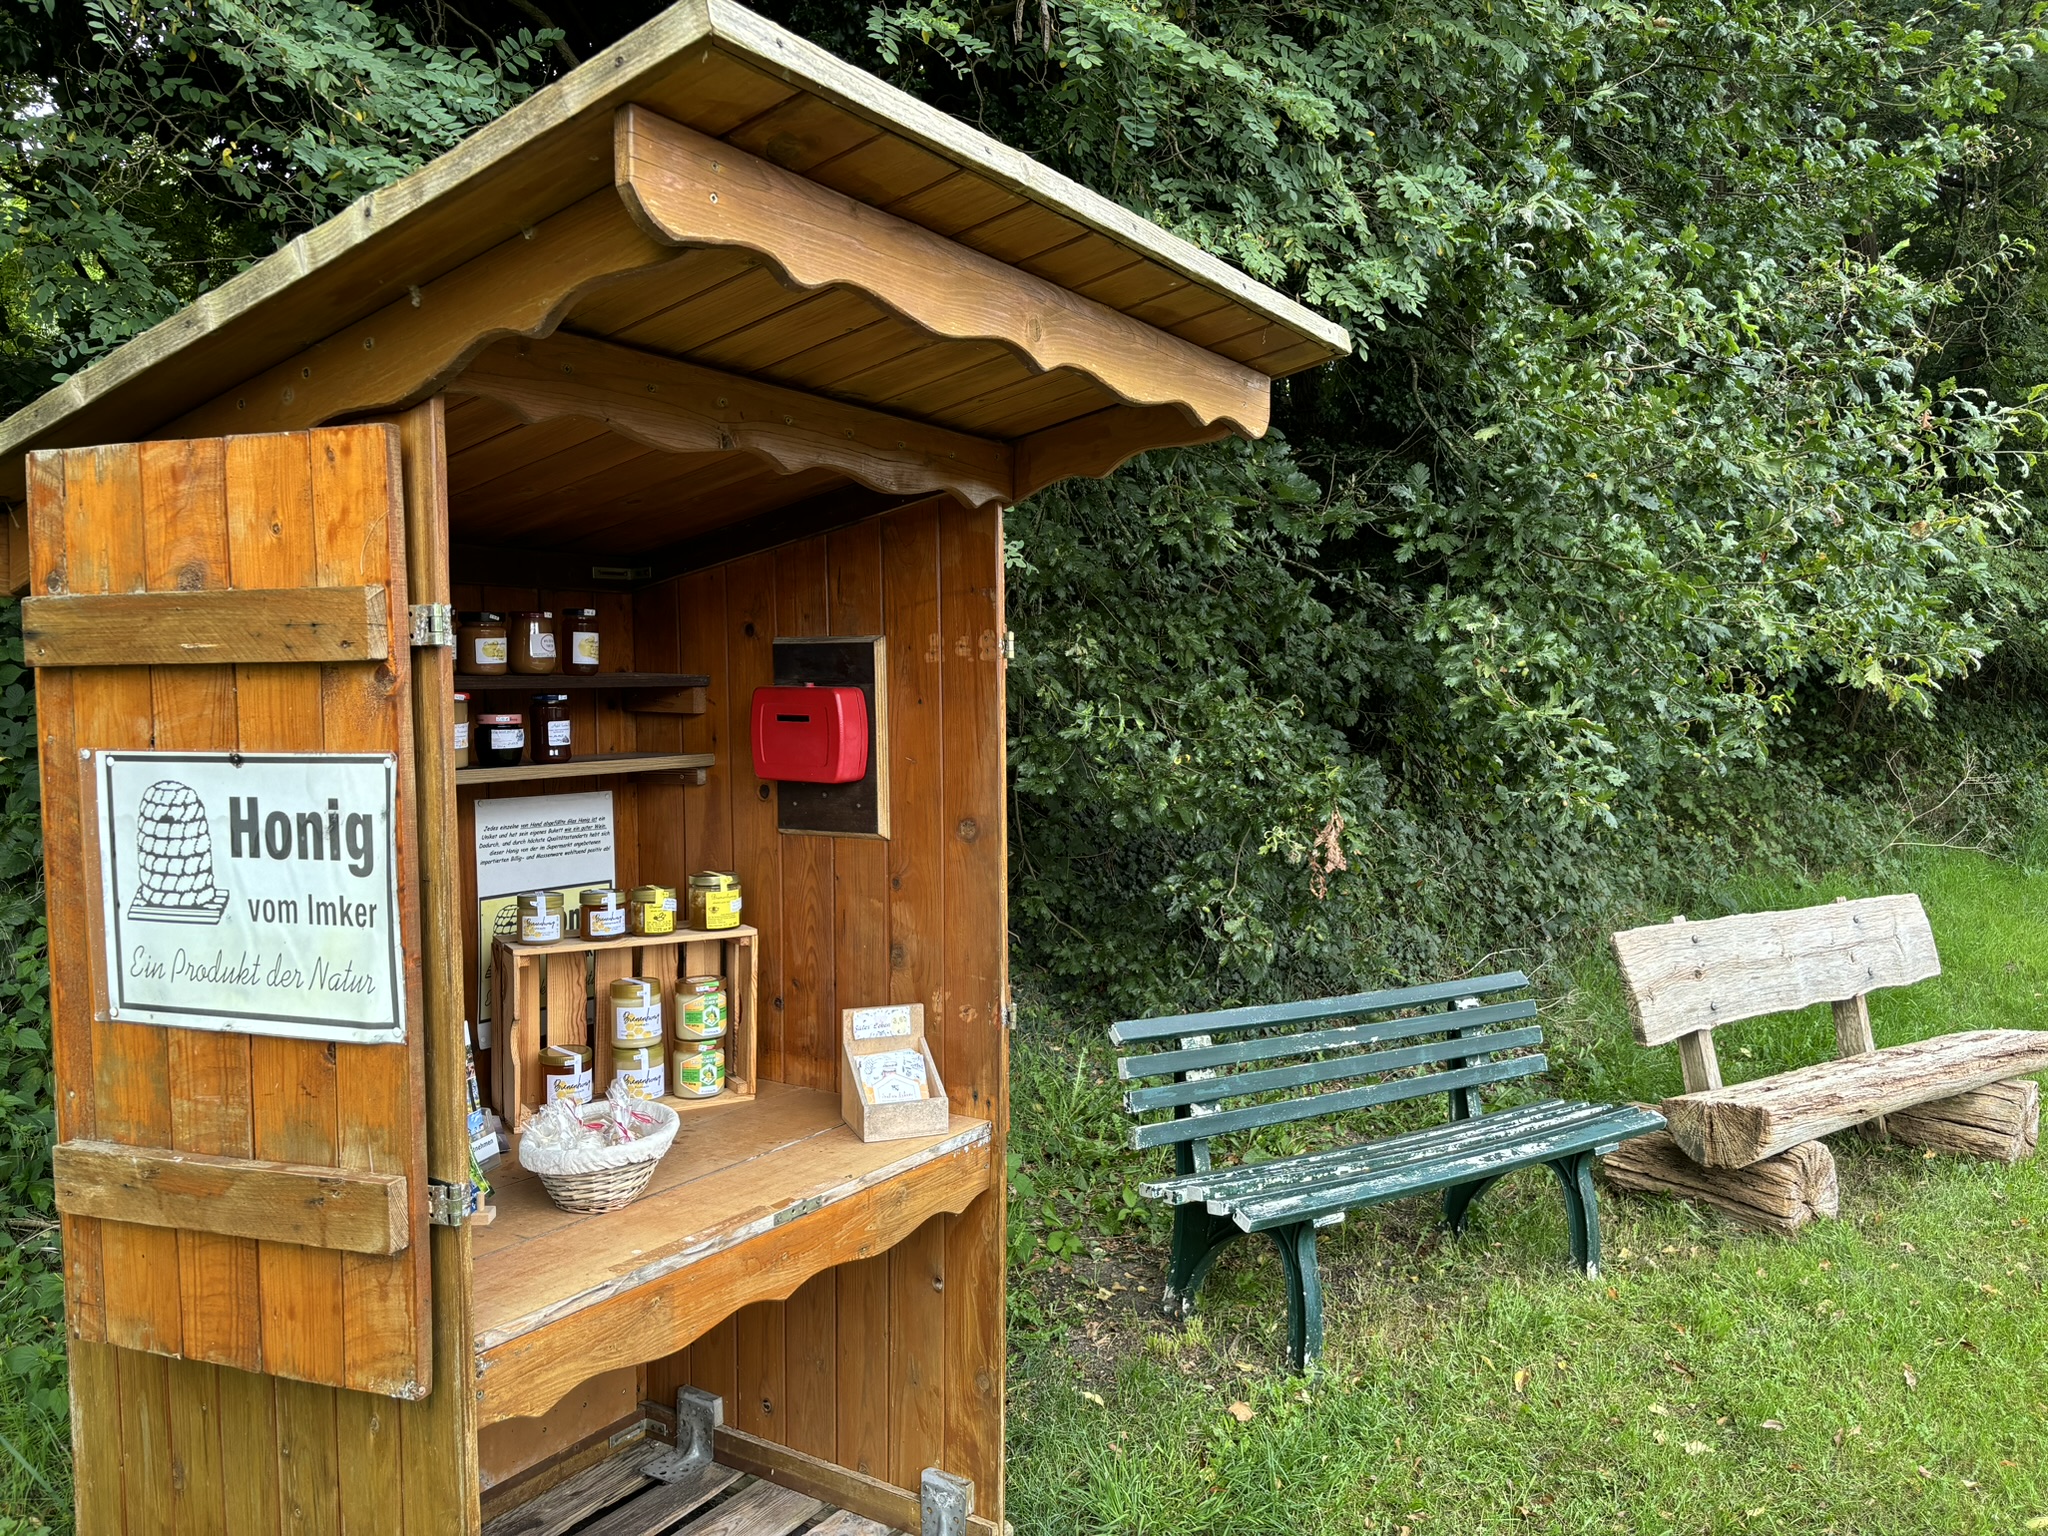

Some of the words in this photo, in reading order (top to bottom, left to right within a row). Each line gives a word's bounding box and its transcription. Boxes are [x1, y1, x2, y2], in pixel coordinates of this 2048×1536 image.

[228, 796, 375, 878] Honig
[546, 842, 573, 850] Supermarkt
[574, 840, 602, 848] angebotenen
[480, 857, 510, 866] importierten
[536, 852, 564, 860] Massenware
[564, 848, 587, 856] wohltuend
[587, 846, 602, 854] positiv
[247, 898, 298, 924] vom
[308, 894, 377, 928] Imker
[130, 945, 166, 978] Ein
[171, 948, 261, 985] Produkt
[266, 952, 304, 988] der
[308, 956, 376, 994] Natur
